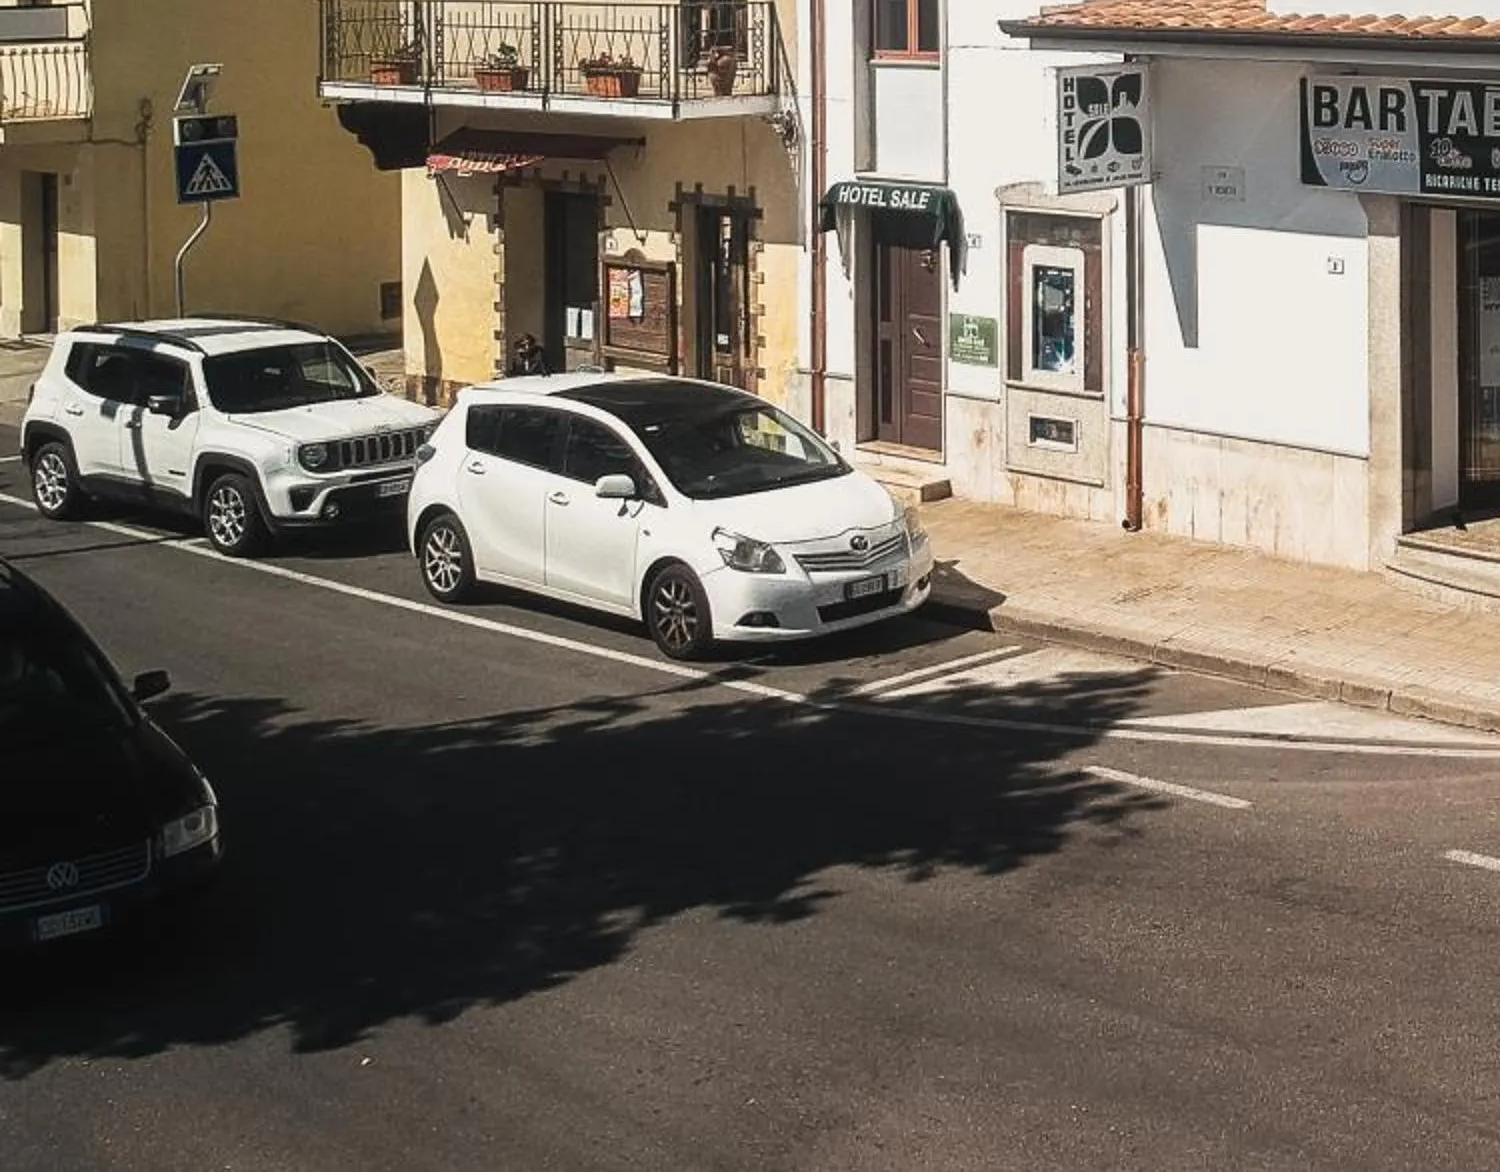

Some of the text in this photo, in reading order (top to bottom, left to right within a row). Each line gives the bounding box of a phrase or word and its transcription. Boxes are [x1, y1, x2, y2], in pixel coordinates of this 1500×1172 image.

[1063, 76, 1075, 163] HOTEL
[1312, 85, 1408, 133] BAR
[838, 185, 930, 209] HOTEL SALE
